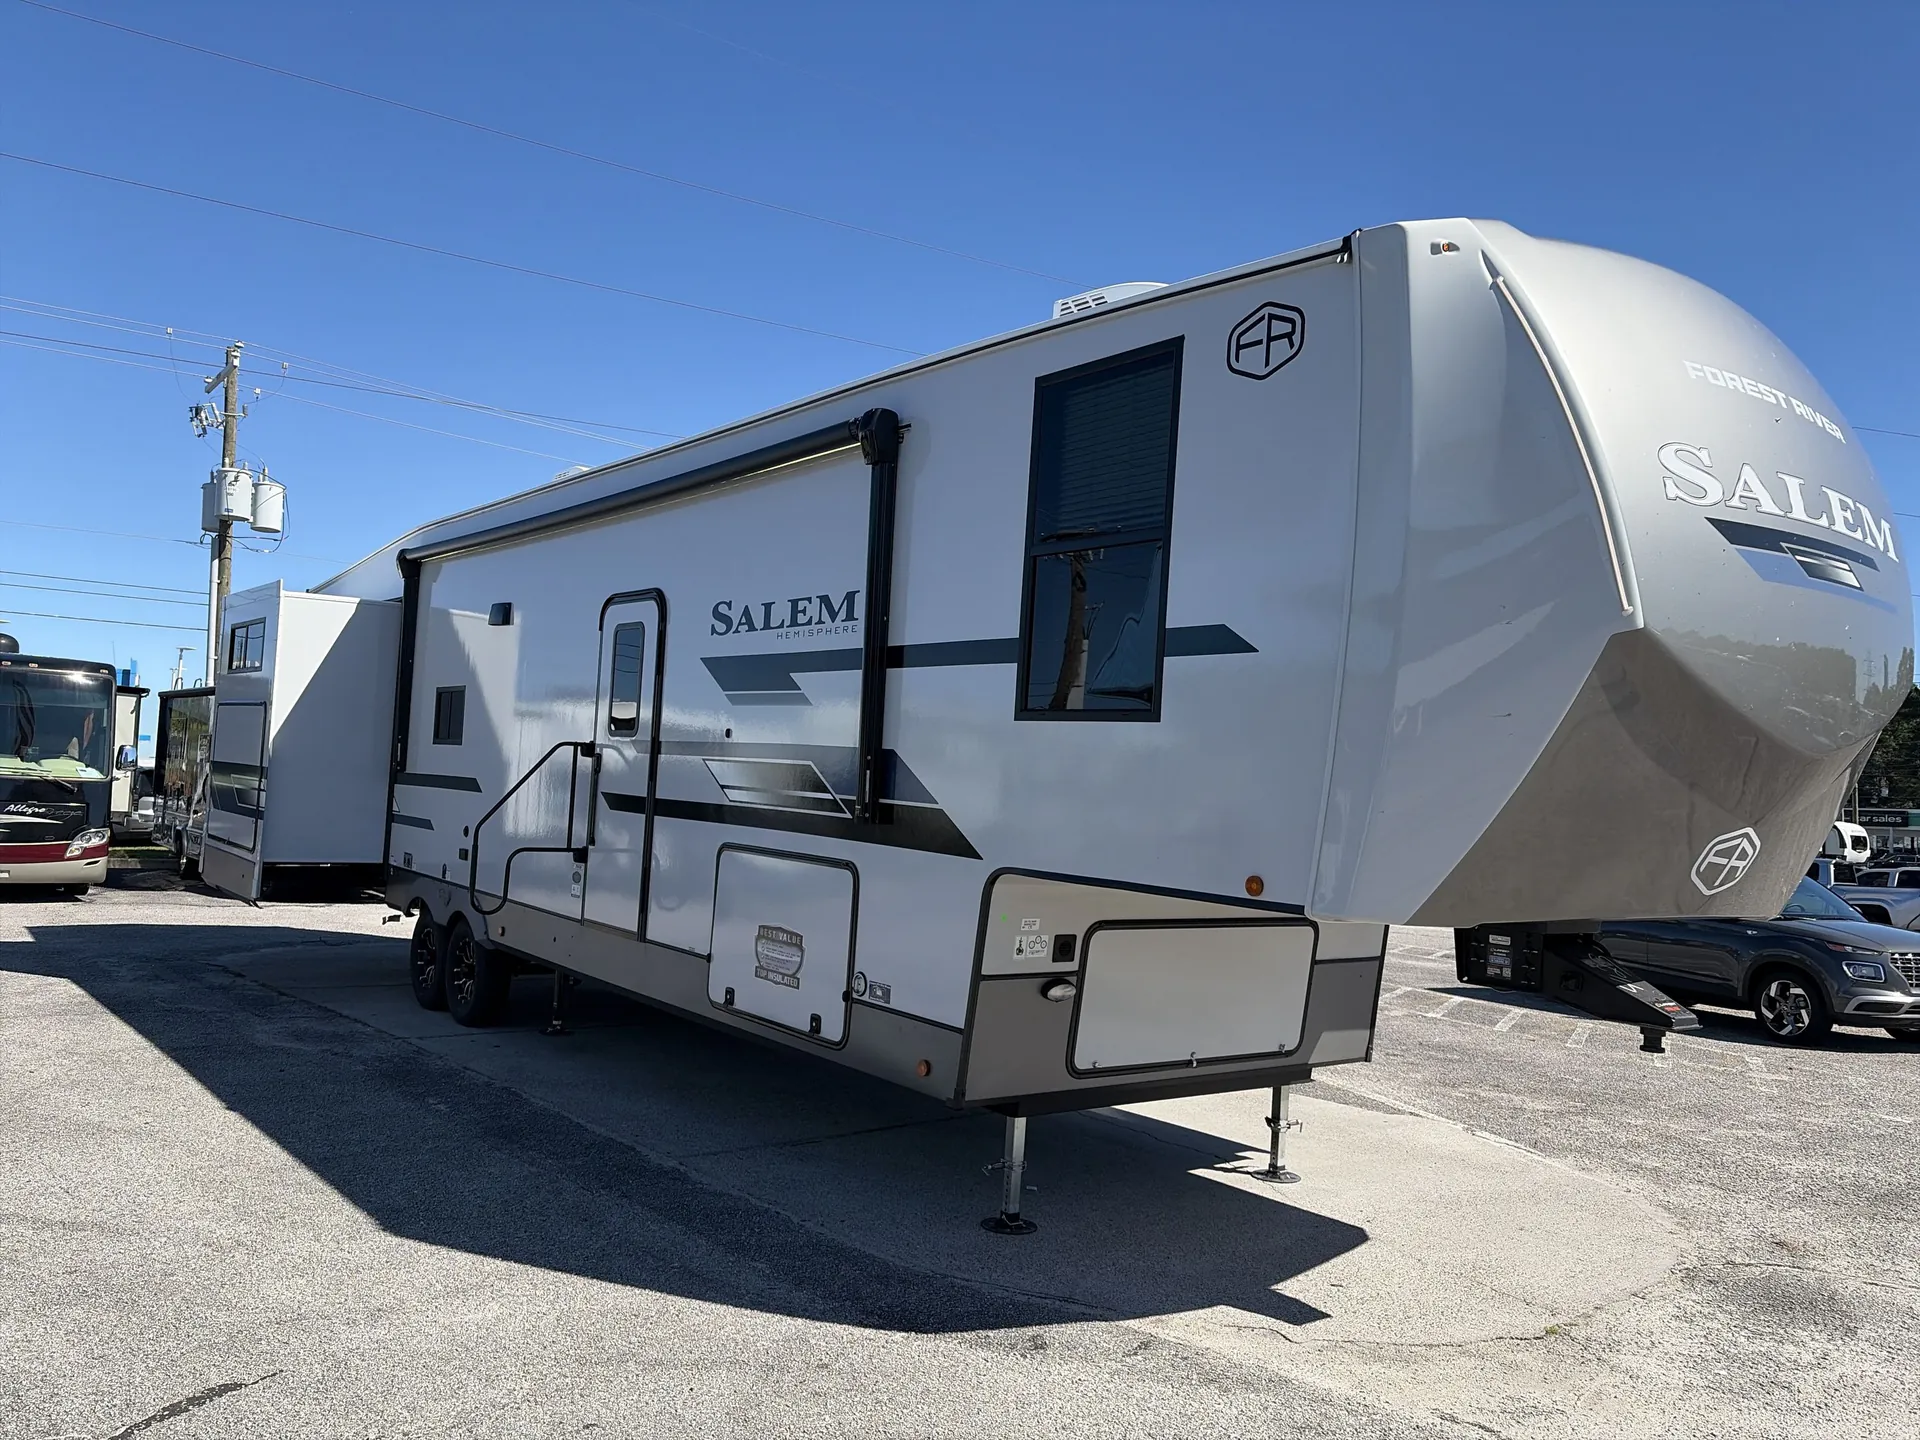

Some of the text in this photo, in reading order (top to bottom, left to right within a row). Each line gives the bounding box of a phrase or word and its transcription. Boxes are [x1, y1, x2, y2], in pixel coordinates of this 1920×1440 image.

[1683, 360, 1847, 444] FOREST RIVER
[1657, 441, 1899, 563] SALEM
[710, 589, 861, 637] SALEM
[776, 624, 858, 640] HEMISPHERE
[3, 804, 46, 815] Allegro
[1872, 814, 1902, 823] sales
[779, 931, 802, 945] VALUE
[756, 968, 798, 987] TOP INSULATED
